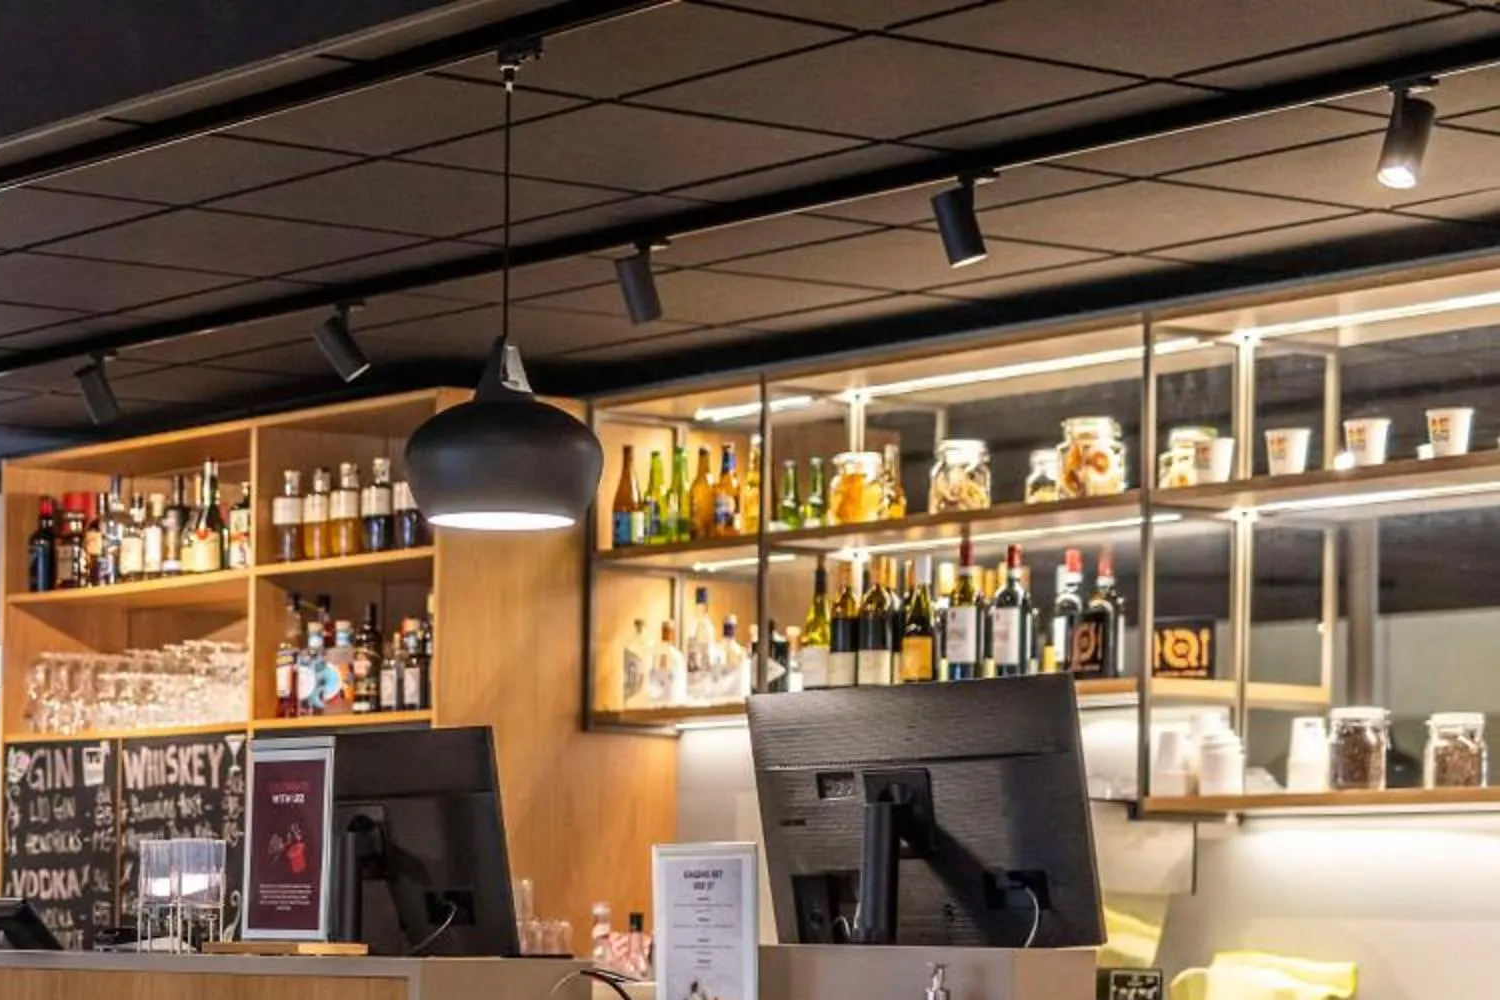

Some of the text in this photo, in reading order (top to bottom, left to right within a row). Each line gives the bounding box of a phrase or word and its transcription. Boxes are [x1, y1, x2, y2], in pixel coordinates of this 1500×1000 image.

[27, 747, 74, 792] GIN
[122, 743, 224, 790] WHISKEY
[11, 867, 82, 900] VODKA
